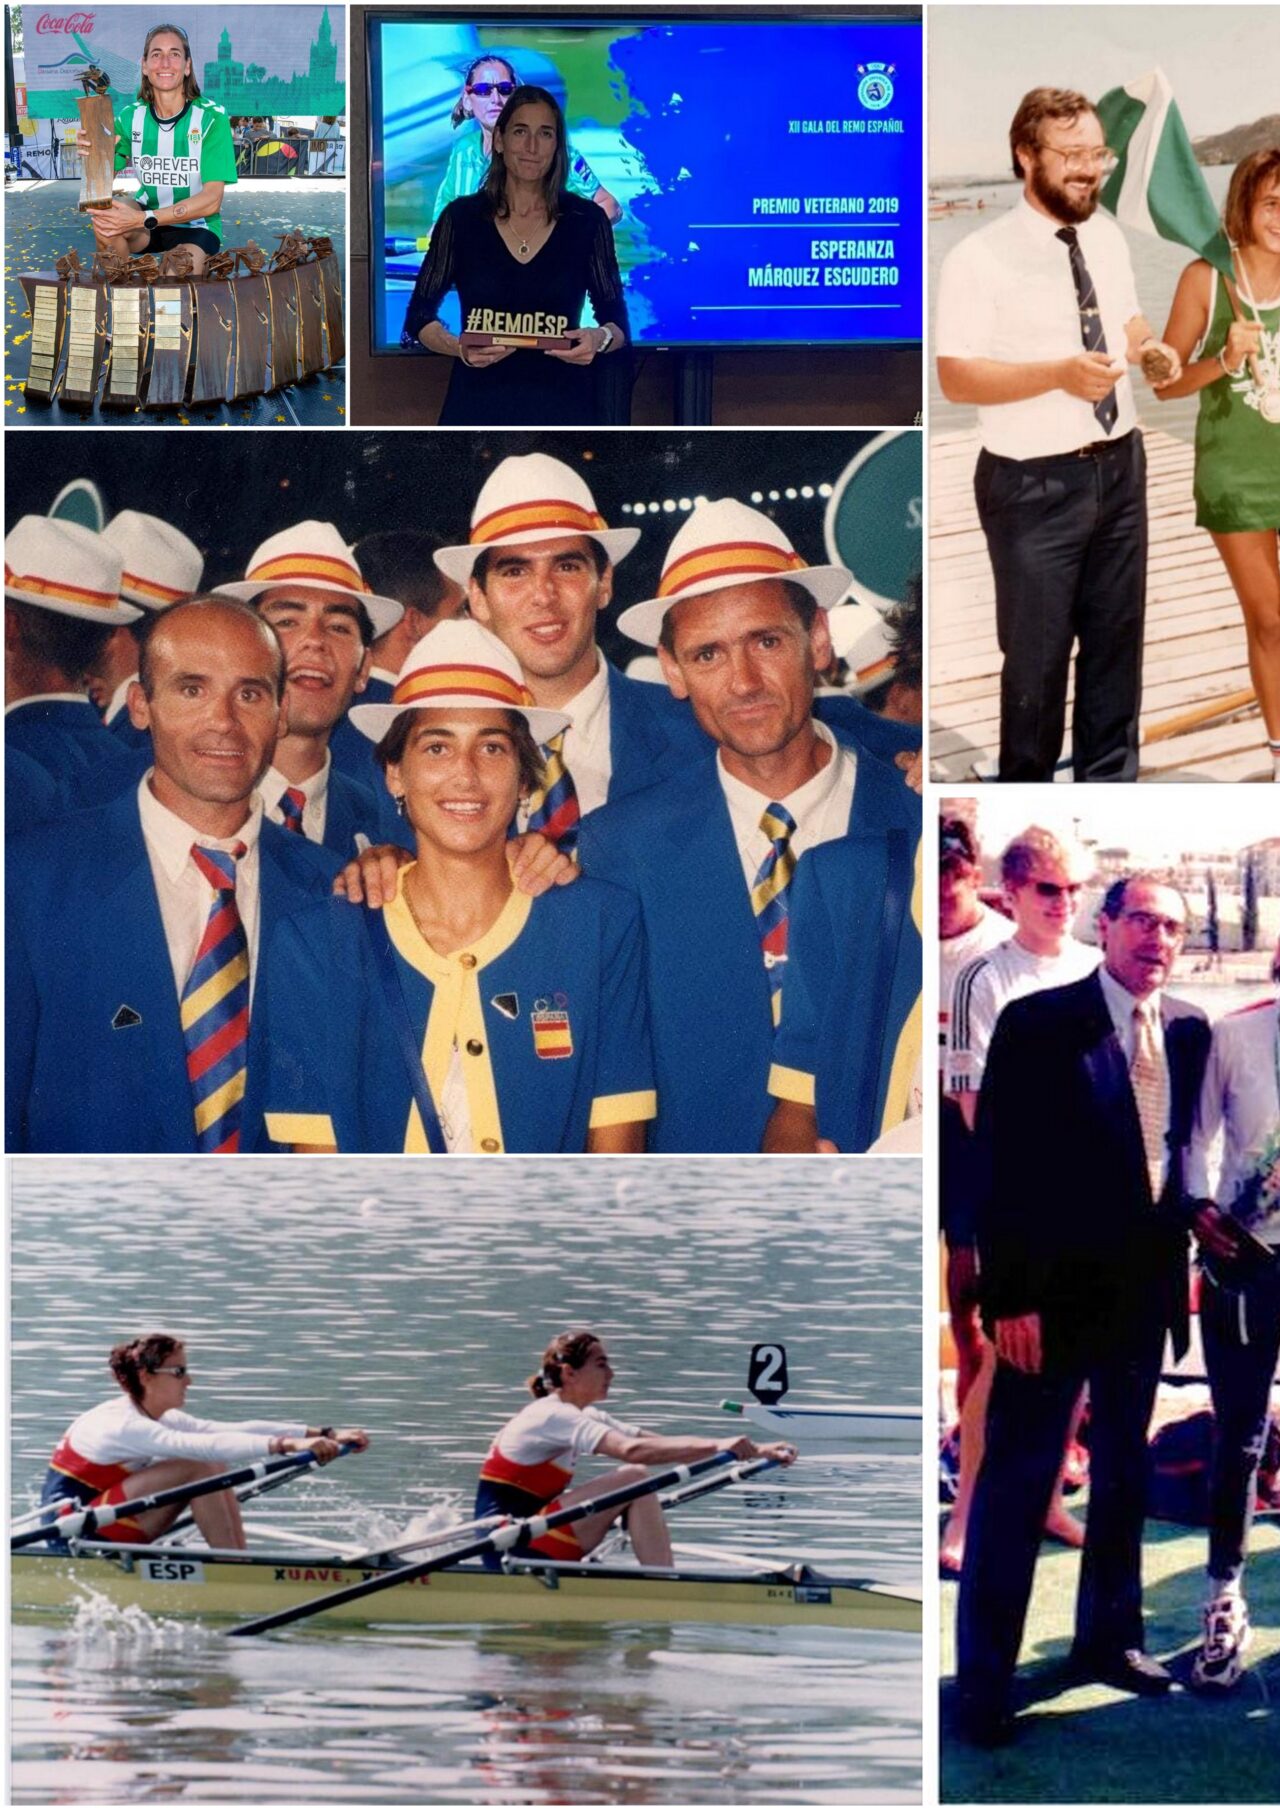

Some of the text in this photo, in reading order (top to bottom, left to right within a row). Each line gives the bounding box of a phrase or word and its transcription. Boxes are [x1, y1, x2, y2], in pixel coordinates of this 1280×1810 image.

[788, 118, 904, 133] XII GALA DEL REMO ESPAÑOL
[26, 149, 51, 158] REMO
[133, 156, 199, 171] FOREVER
[143, 172, 188, 186] GREEN
[752, 197, 899, 214] PREMIO VETERANO 2019
[811, 240, 894, 260] ESPERANZA
[748, 263, 899, 288] MÁRQUEZ ESCUDERO
[755, 1345, 783, 1391] 2
[149, 1563, 196, 1581] ESP
